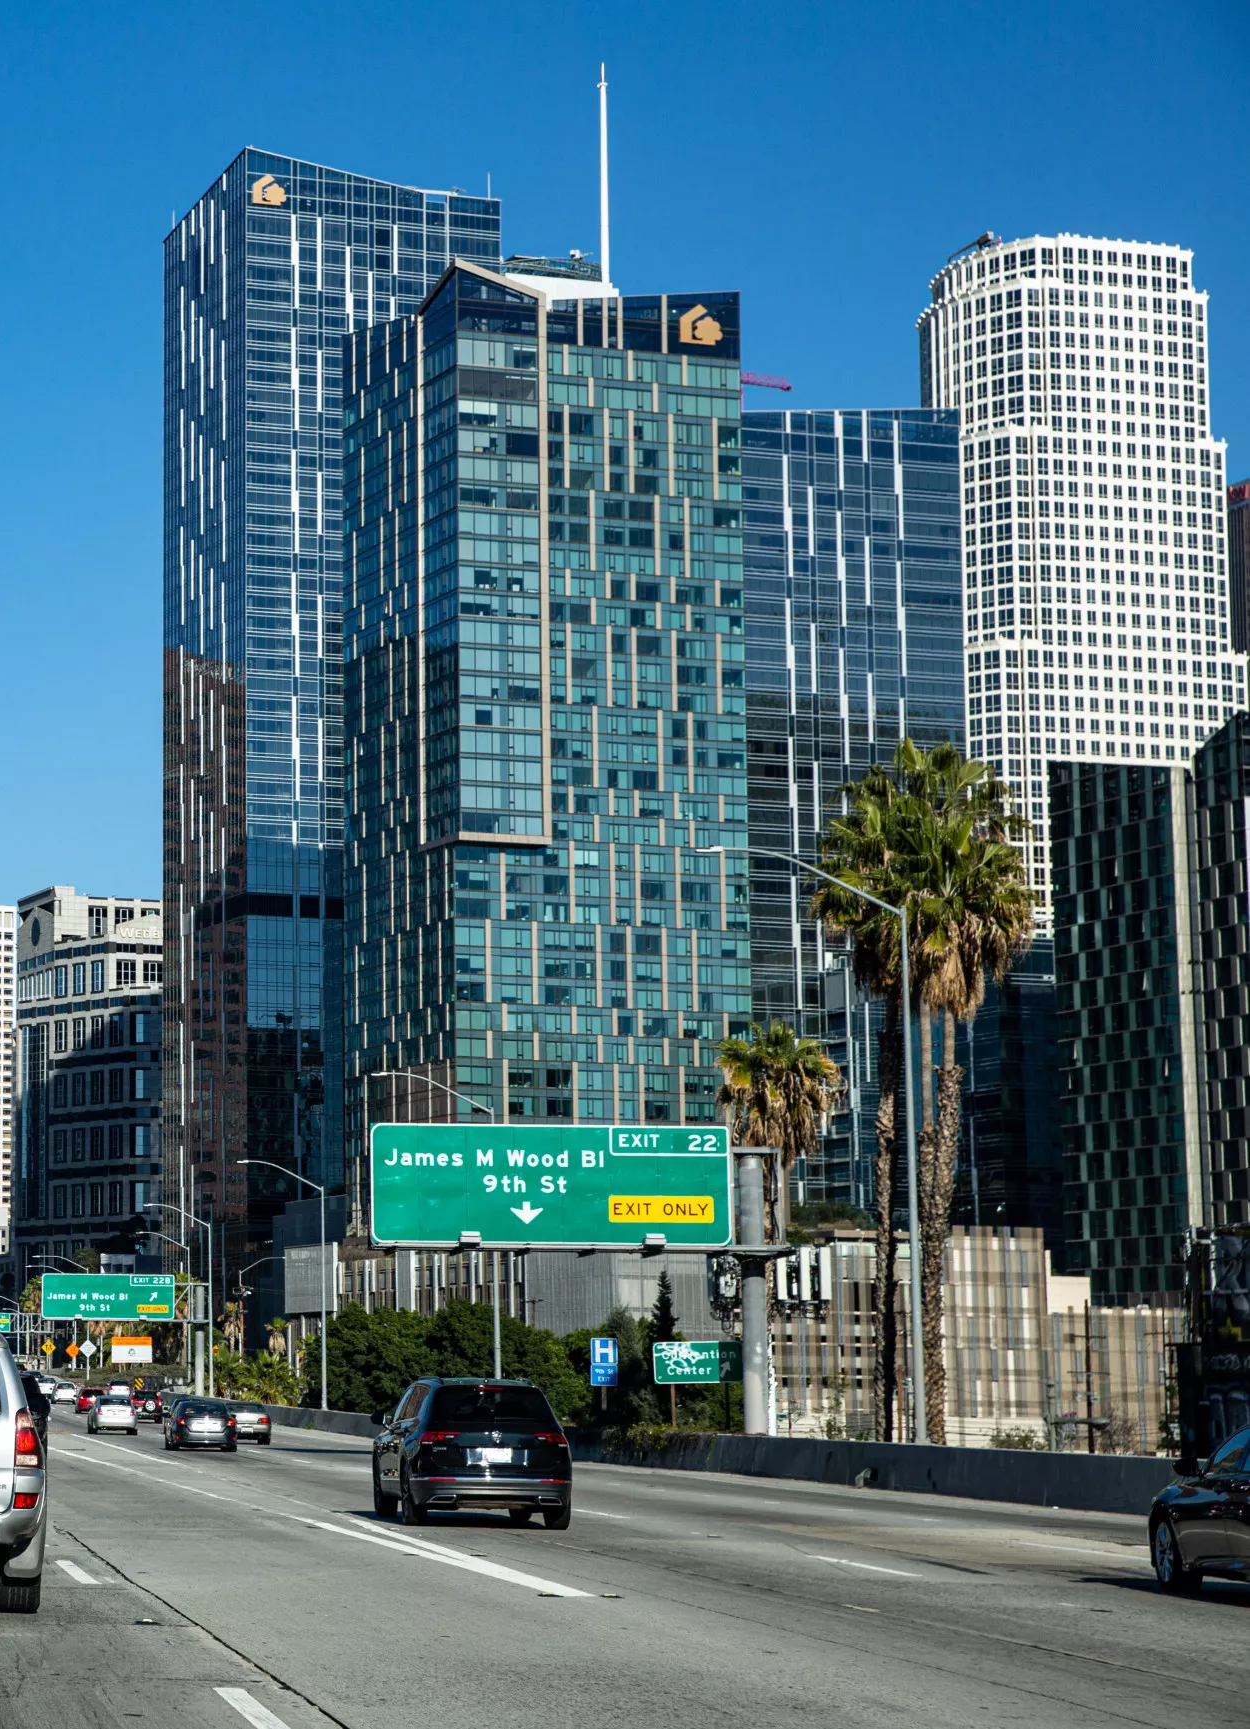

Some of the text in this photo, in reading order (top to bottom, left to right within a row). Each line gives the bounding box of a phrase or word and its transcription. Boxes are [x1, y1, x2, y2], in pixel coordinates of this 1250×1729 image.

[120, 927, 162, 939] WEDB
[618, 1134, 717, 1152] EXIT 22
[384, 1148, 605, 1168] James M Wood Bl
[483, 1175, 567, 1194] 9th St
[613, 1202, 709, 1216] EXIT ONLY
[47, 1292, 128, 1301] James M Wood Bl
[79, 1303, 111, 1312] 9th St
[594, 1339, 614, 1363] H
[667, 1366, 712, 1376] Center
